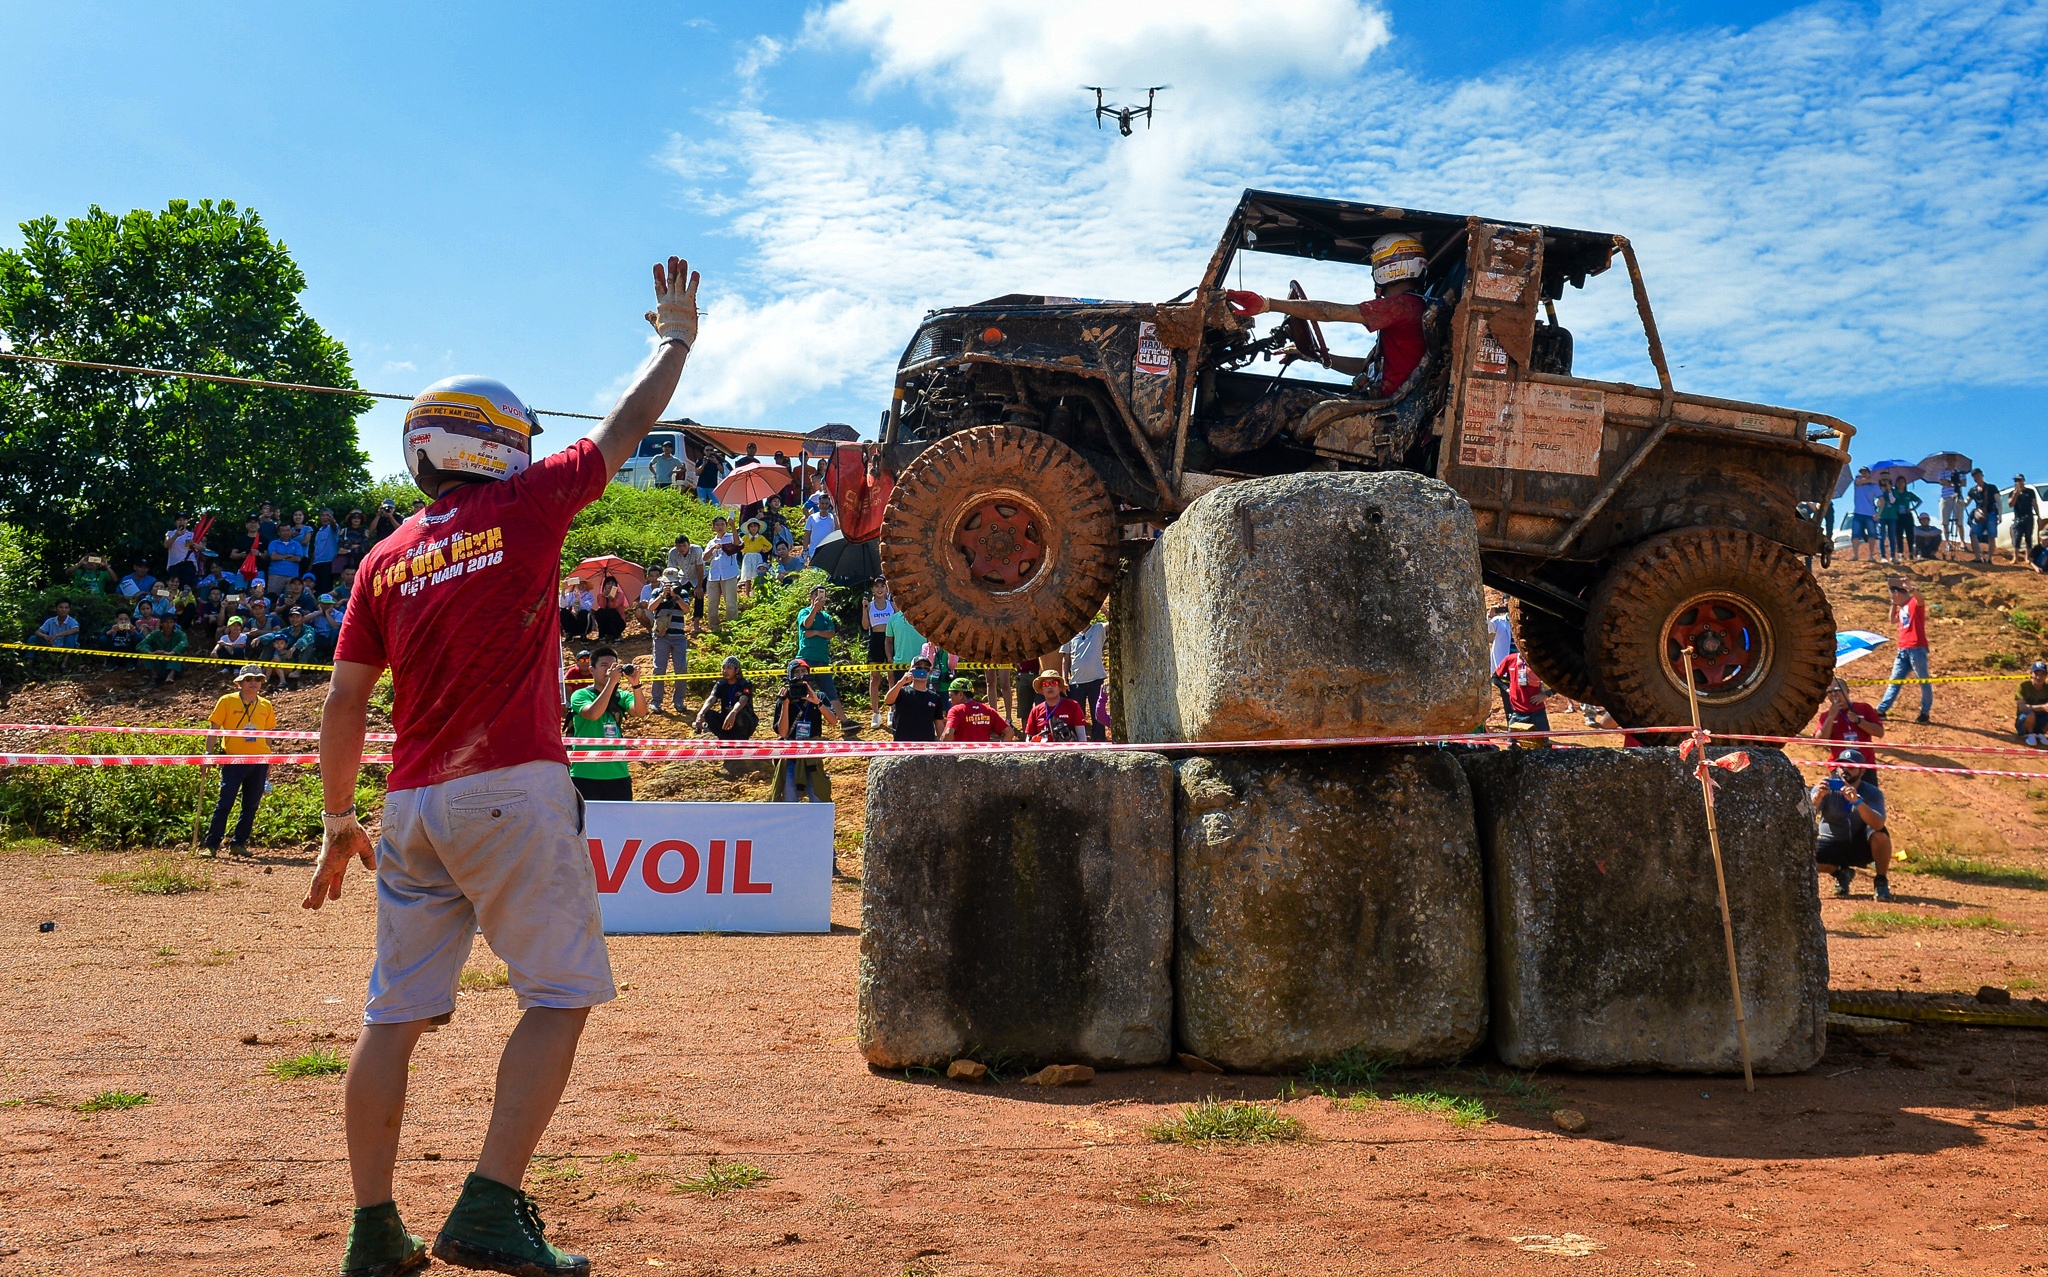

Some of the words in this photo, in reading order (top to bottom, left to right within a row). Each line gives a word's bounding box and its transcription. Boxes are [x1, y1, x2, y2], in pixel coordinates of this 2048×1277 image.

[1139, 354, 1169, 366] CLUB
[449, 409, 462, 417] NAM
[464, 411, 480, 419] 2018
[503, 405, 524, 418] PVOIL
[467, 453, 477, 462] TÔ
[373, 570, 382, 597] Ô
[385, 556, 407, 588] TÔ
[411, 549, 447, 578] ĐỊA
[451, 527, 503, 563] HÌNH
[400, 576, 427, 597] VIỆT
[431, 562, 464, 586] NAM
[467, 551, 503, 573] 2018
